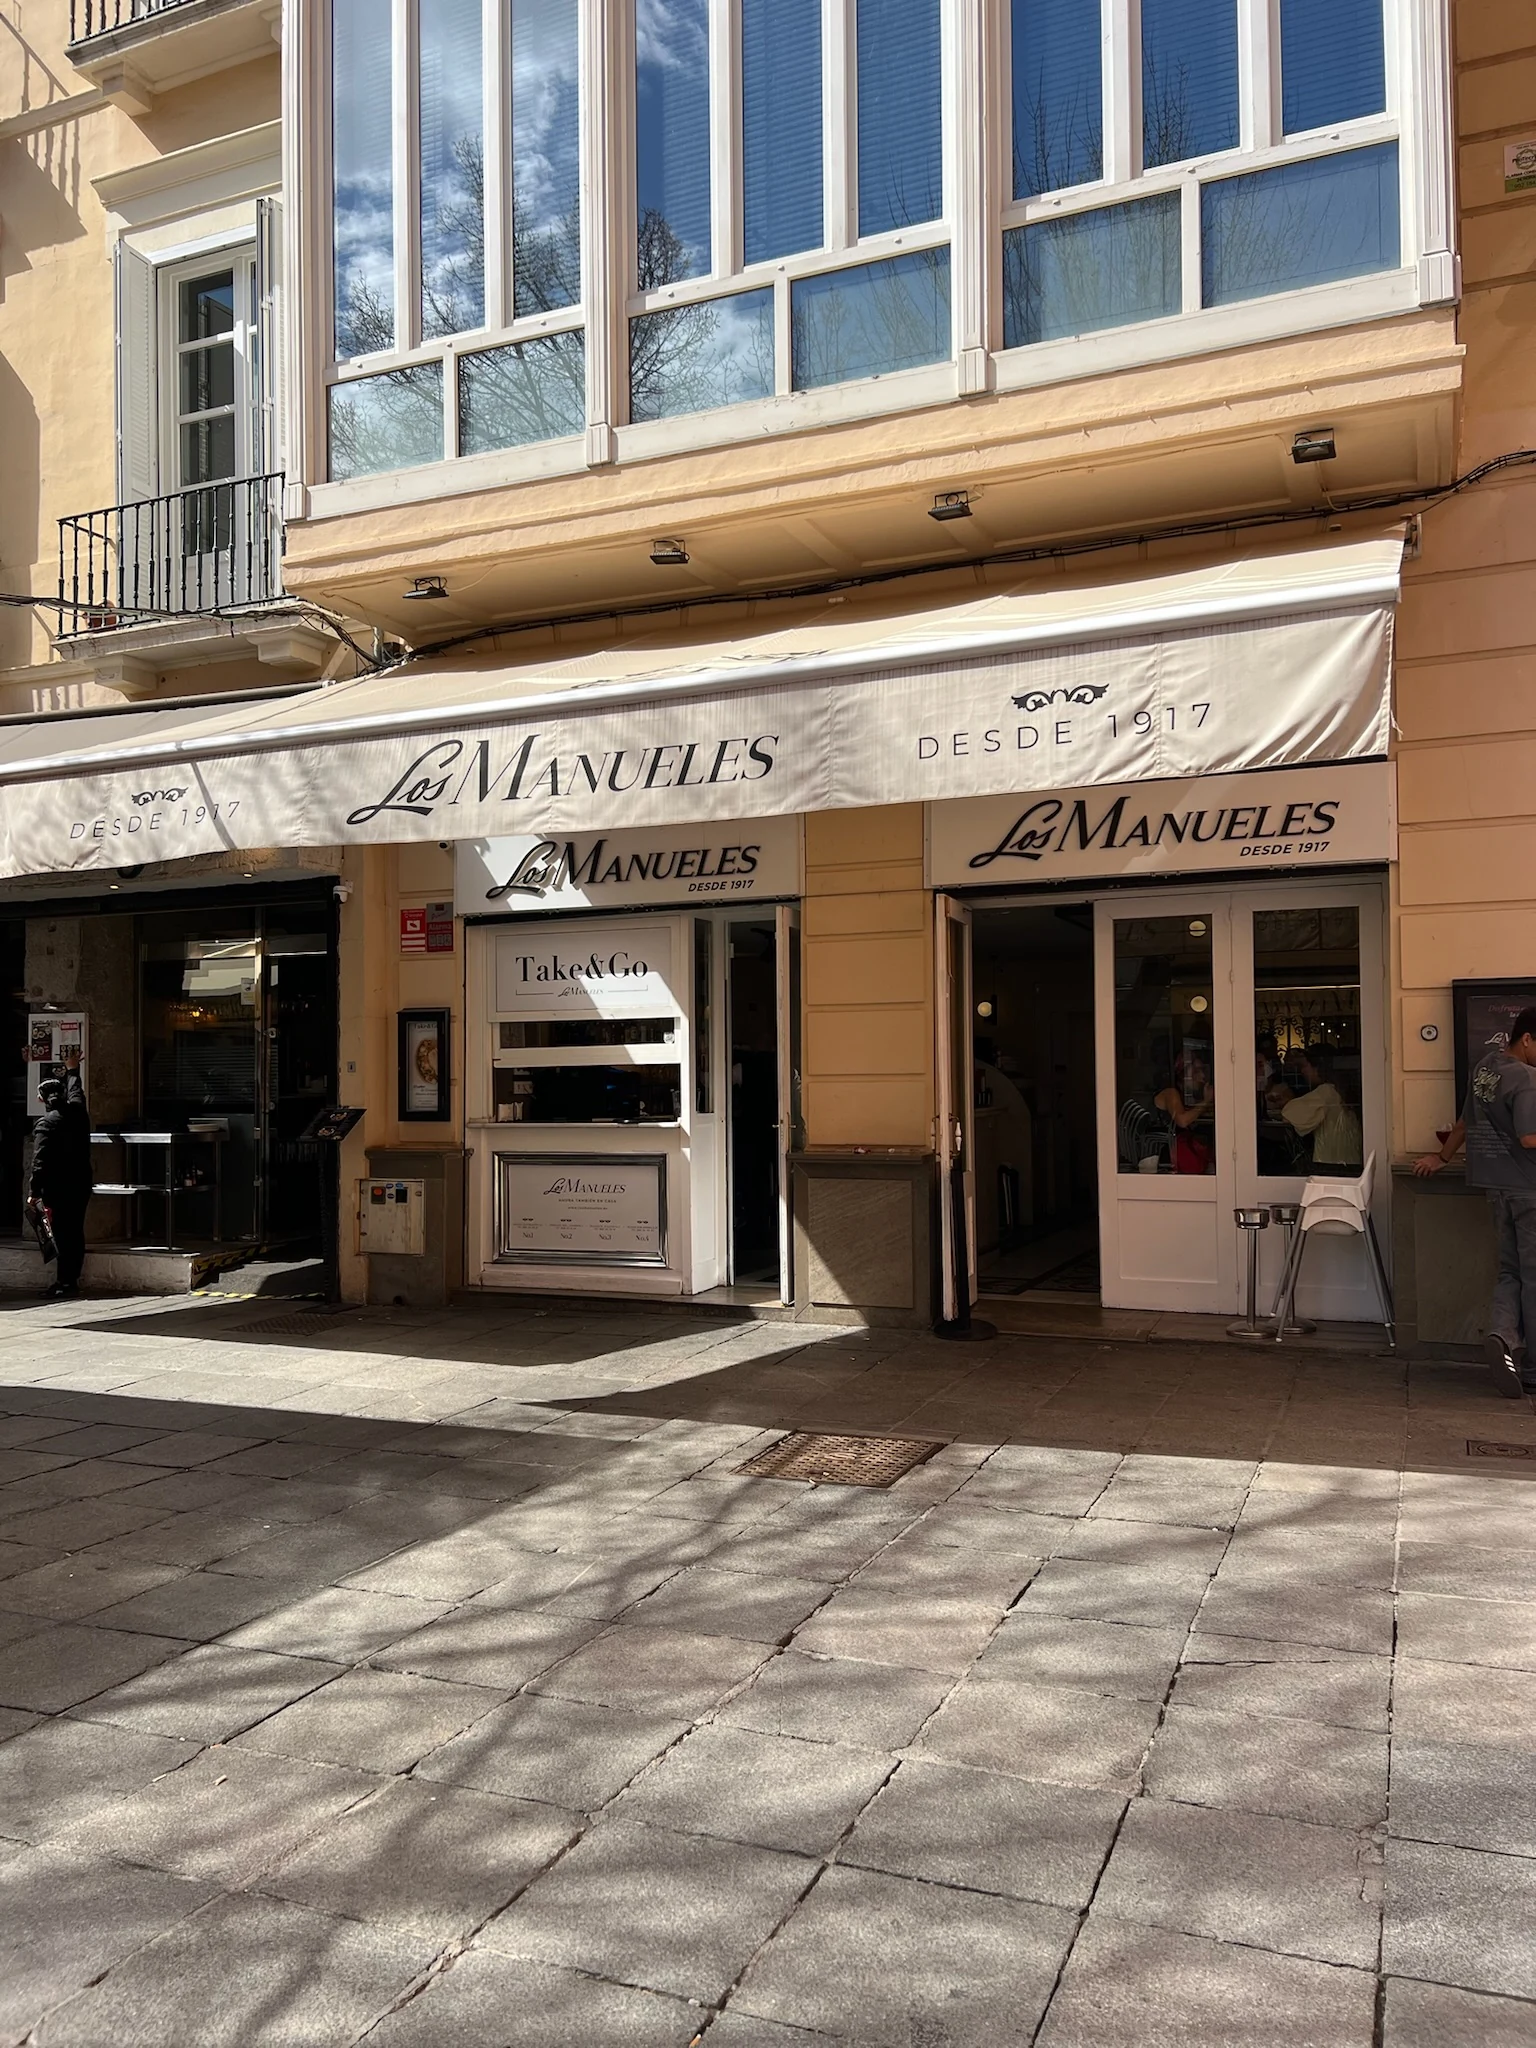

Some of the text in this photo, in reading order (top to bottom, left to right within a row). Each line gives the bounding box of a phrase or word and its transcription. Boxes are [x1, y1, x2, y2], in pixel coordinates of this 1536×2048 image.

[918, 702, 1212, 760] DESDE 1917
[346, 734, 780, 825] Los MANUELES
[70, 801, 240, 840] DESDE 1917
[969, 796, 1340, 869] Los MANUELES
[1239, 841, 1330, 857] DESDE 1917
[486, 838, 761, 900] Los MANUELES
[688, 879, 755, 893] DESDE 1917
[515, 951, 648, 982] Take&Go
[543, 1178, 566, 1195] Los
